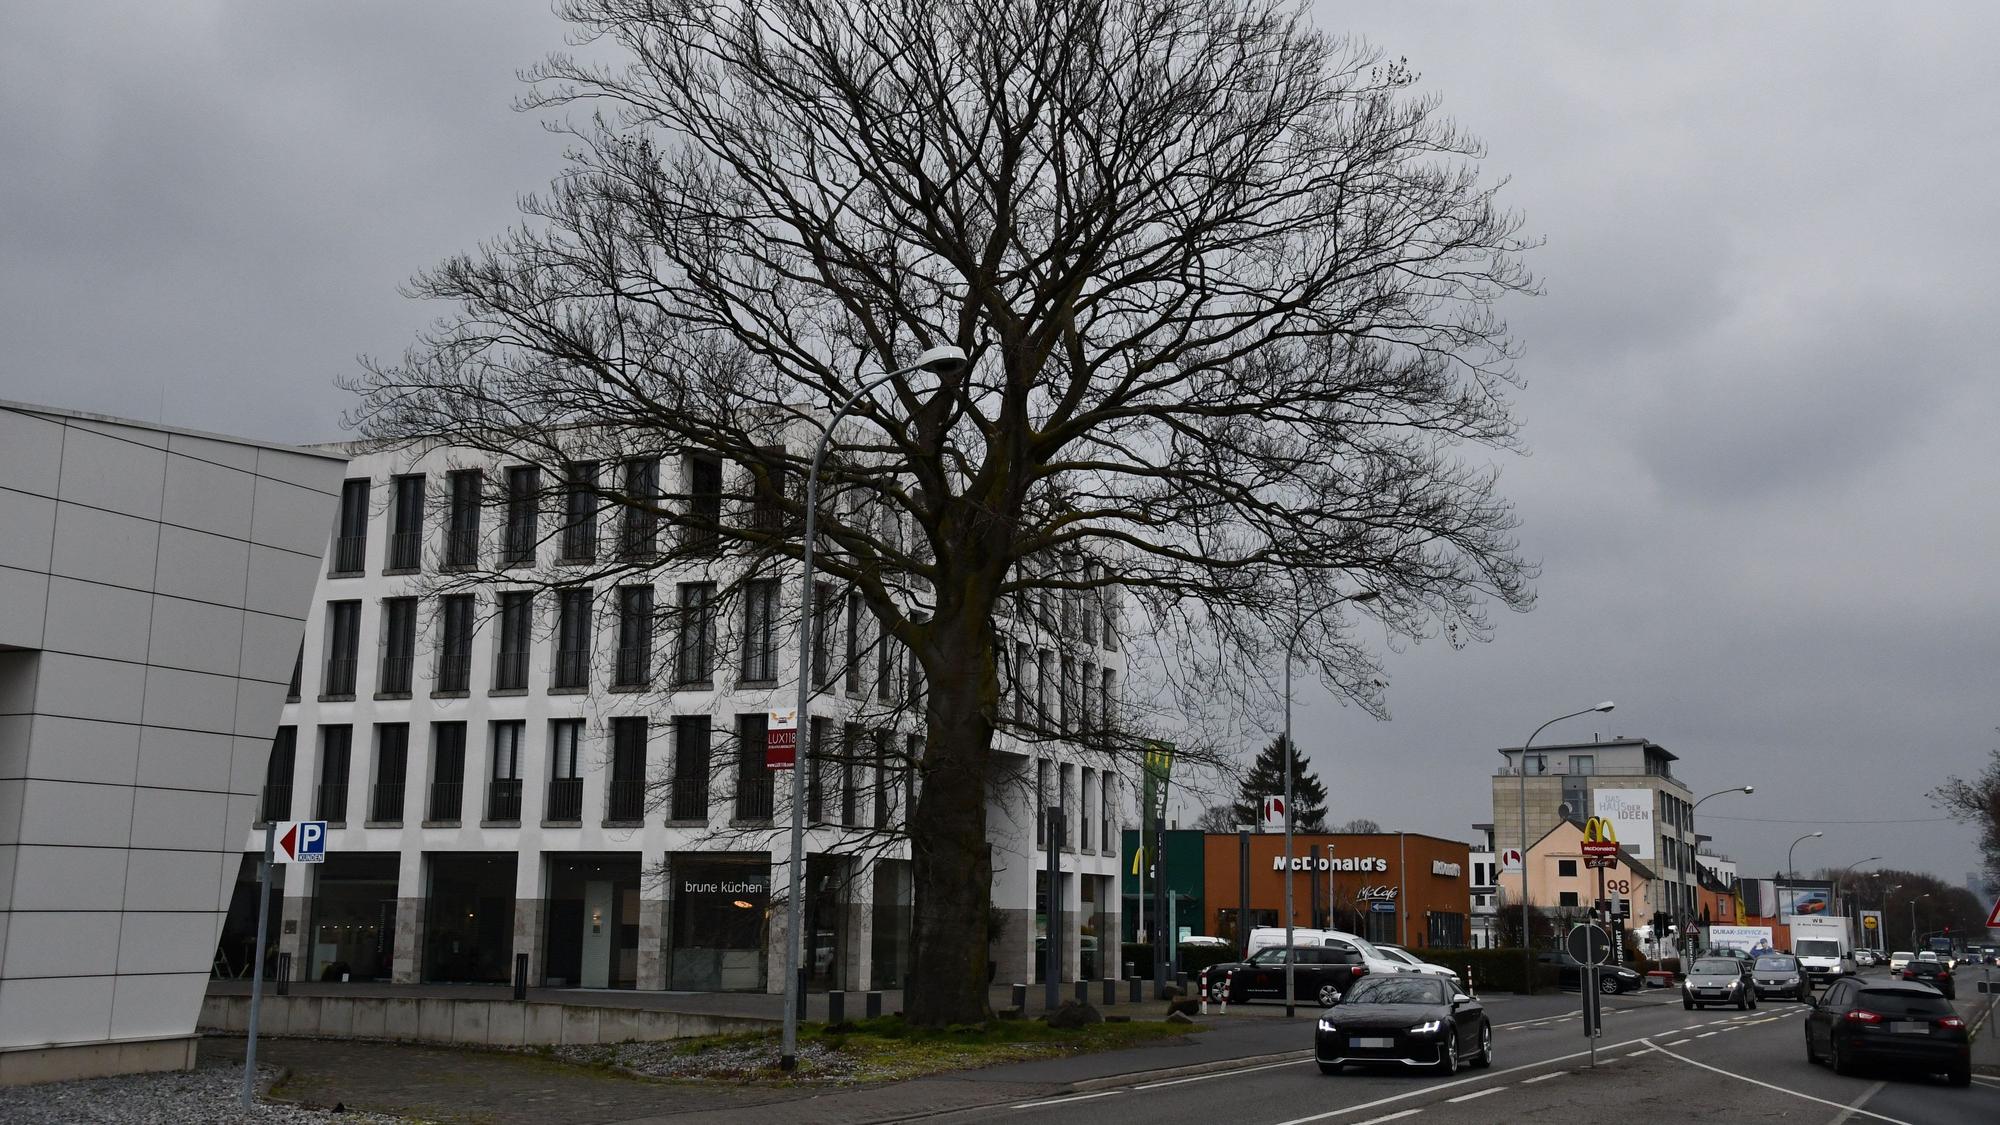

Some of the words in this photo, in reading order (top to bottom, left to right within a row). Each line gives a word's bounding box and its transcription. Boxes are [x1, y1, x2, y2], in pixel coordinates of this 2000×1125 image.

[768, 733, 796, 744] LUX118
[1600, 802, 1627, 811] HAUS
[1618, 811, 1649, 820] IDEEN
[303, 824, 321, 852] P
[1273, 856, 1387, 872] McDonald's
[685, 881, 718, 893] brune
[721, 881, 763, 893] küchen
[1607, 879, 1630, 895] 98
[1614, 929, 1625, 966] USFAHRT
